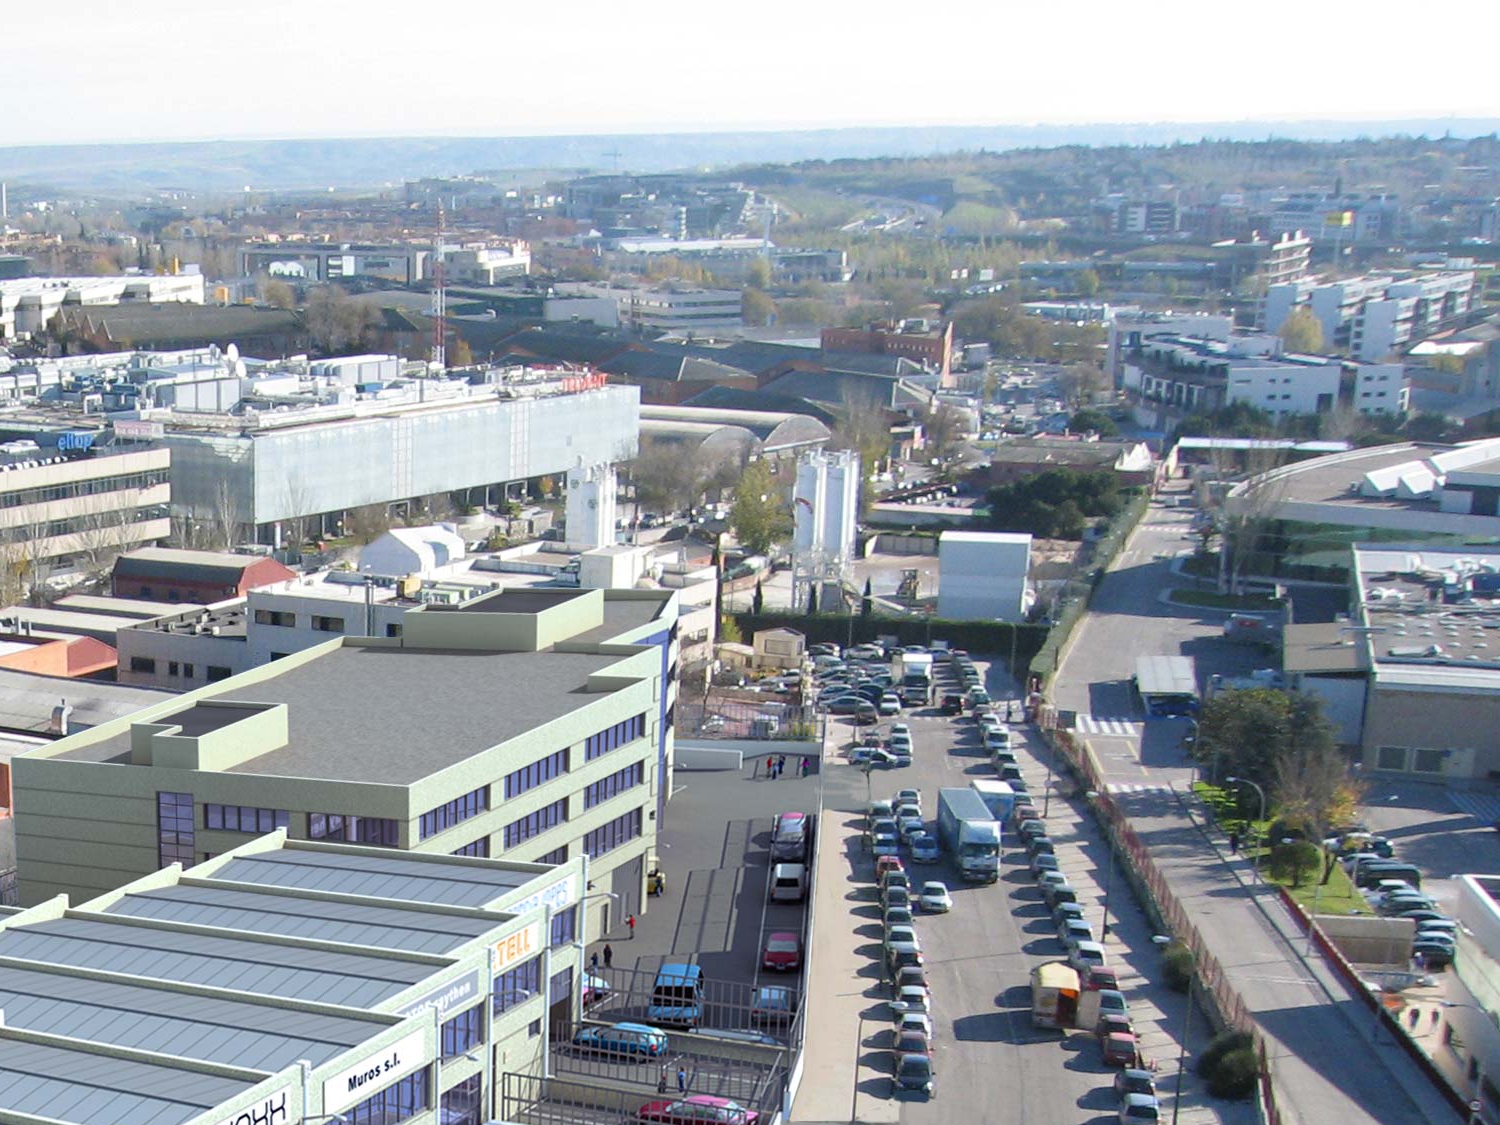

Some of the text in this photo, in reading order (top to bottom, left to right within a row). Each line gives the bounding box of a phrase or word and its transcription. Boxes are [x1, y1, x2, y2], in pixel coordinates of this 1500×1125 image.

[493, 928, 530, 970] TELL
[348, 1052, 401, 1092] Muros s.l.
